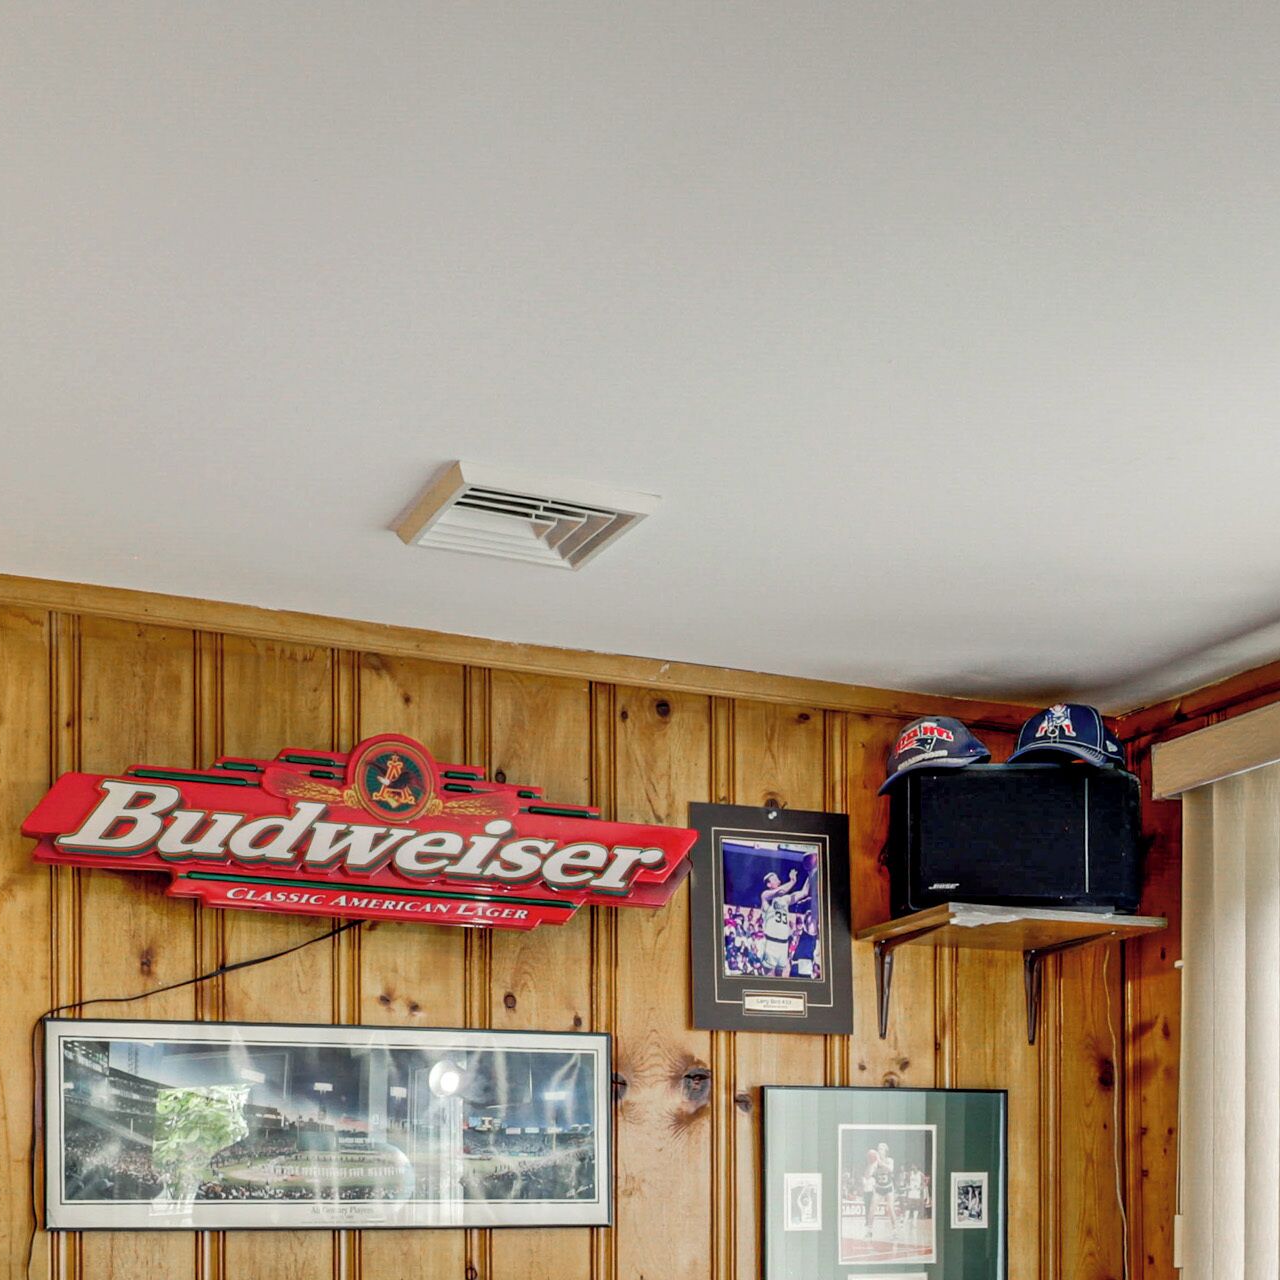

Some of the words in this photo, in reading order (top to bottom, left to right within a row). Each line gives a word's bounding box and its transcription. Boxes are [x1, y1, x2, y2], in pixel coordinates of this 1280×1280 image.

[57, 779, 664, 893] Budweiser
[225, 886, 324, 905] CLASSIC
[329, 894, 451, 914] AMERICAN
[455, 903, 529, 920] LAGER
[775, 911, 787, 924] 33
